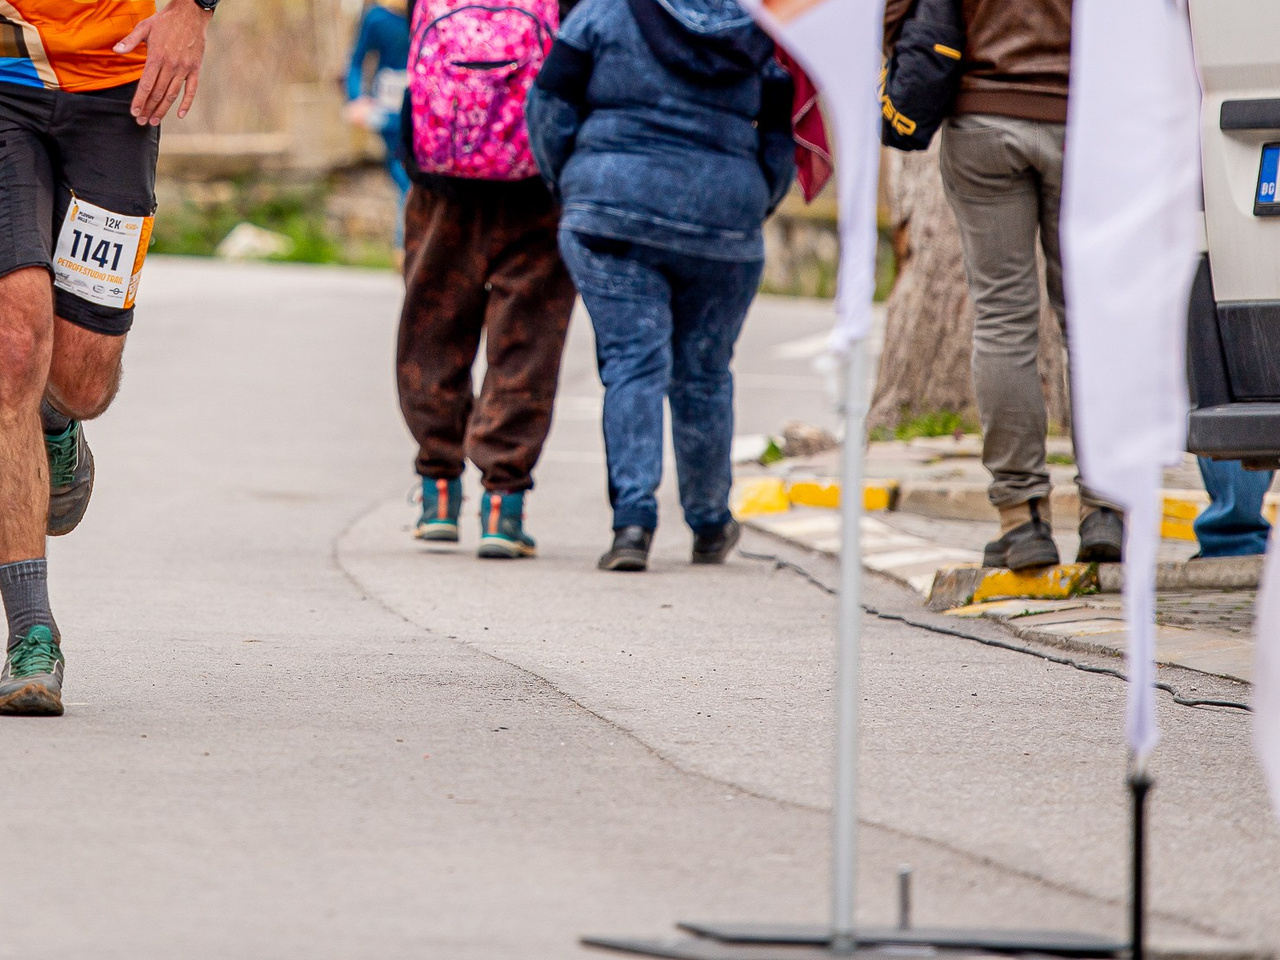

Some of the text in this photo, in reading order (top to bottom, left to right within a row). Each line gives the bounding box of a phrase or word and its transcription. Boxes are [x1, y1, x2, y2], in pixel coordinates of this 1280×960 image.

[105, 217, 121, 229] 12K
[71, 229, 123, 271] 1141
[107, 275, 123, 284] TRAIL
